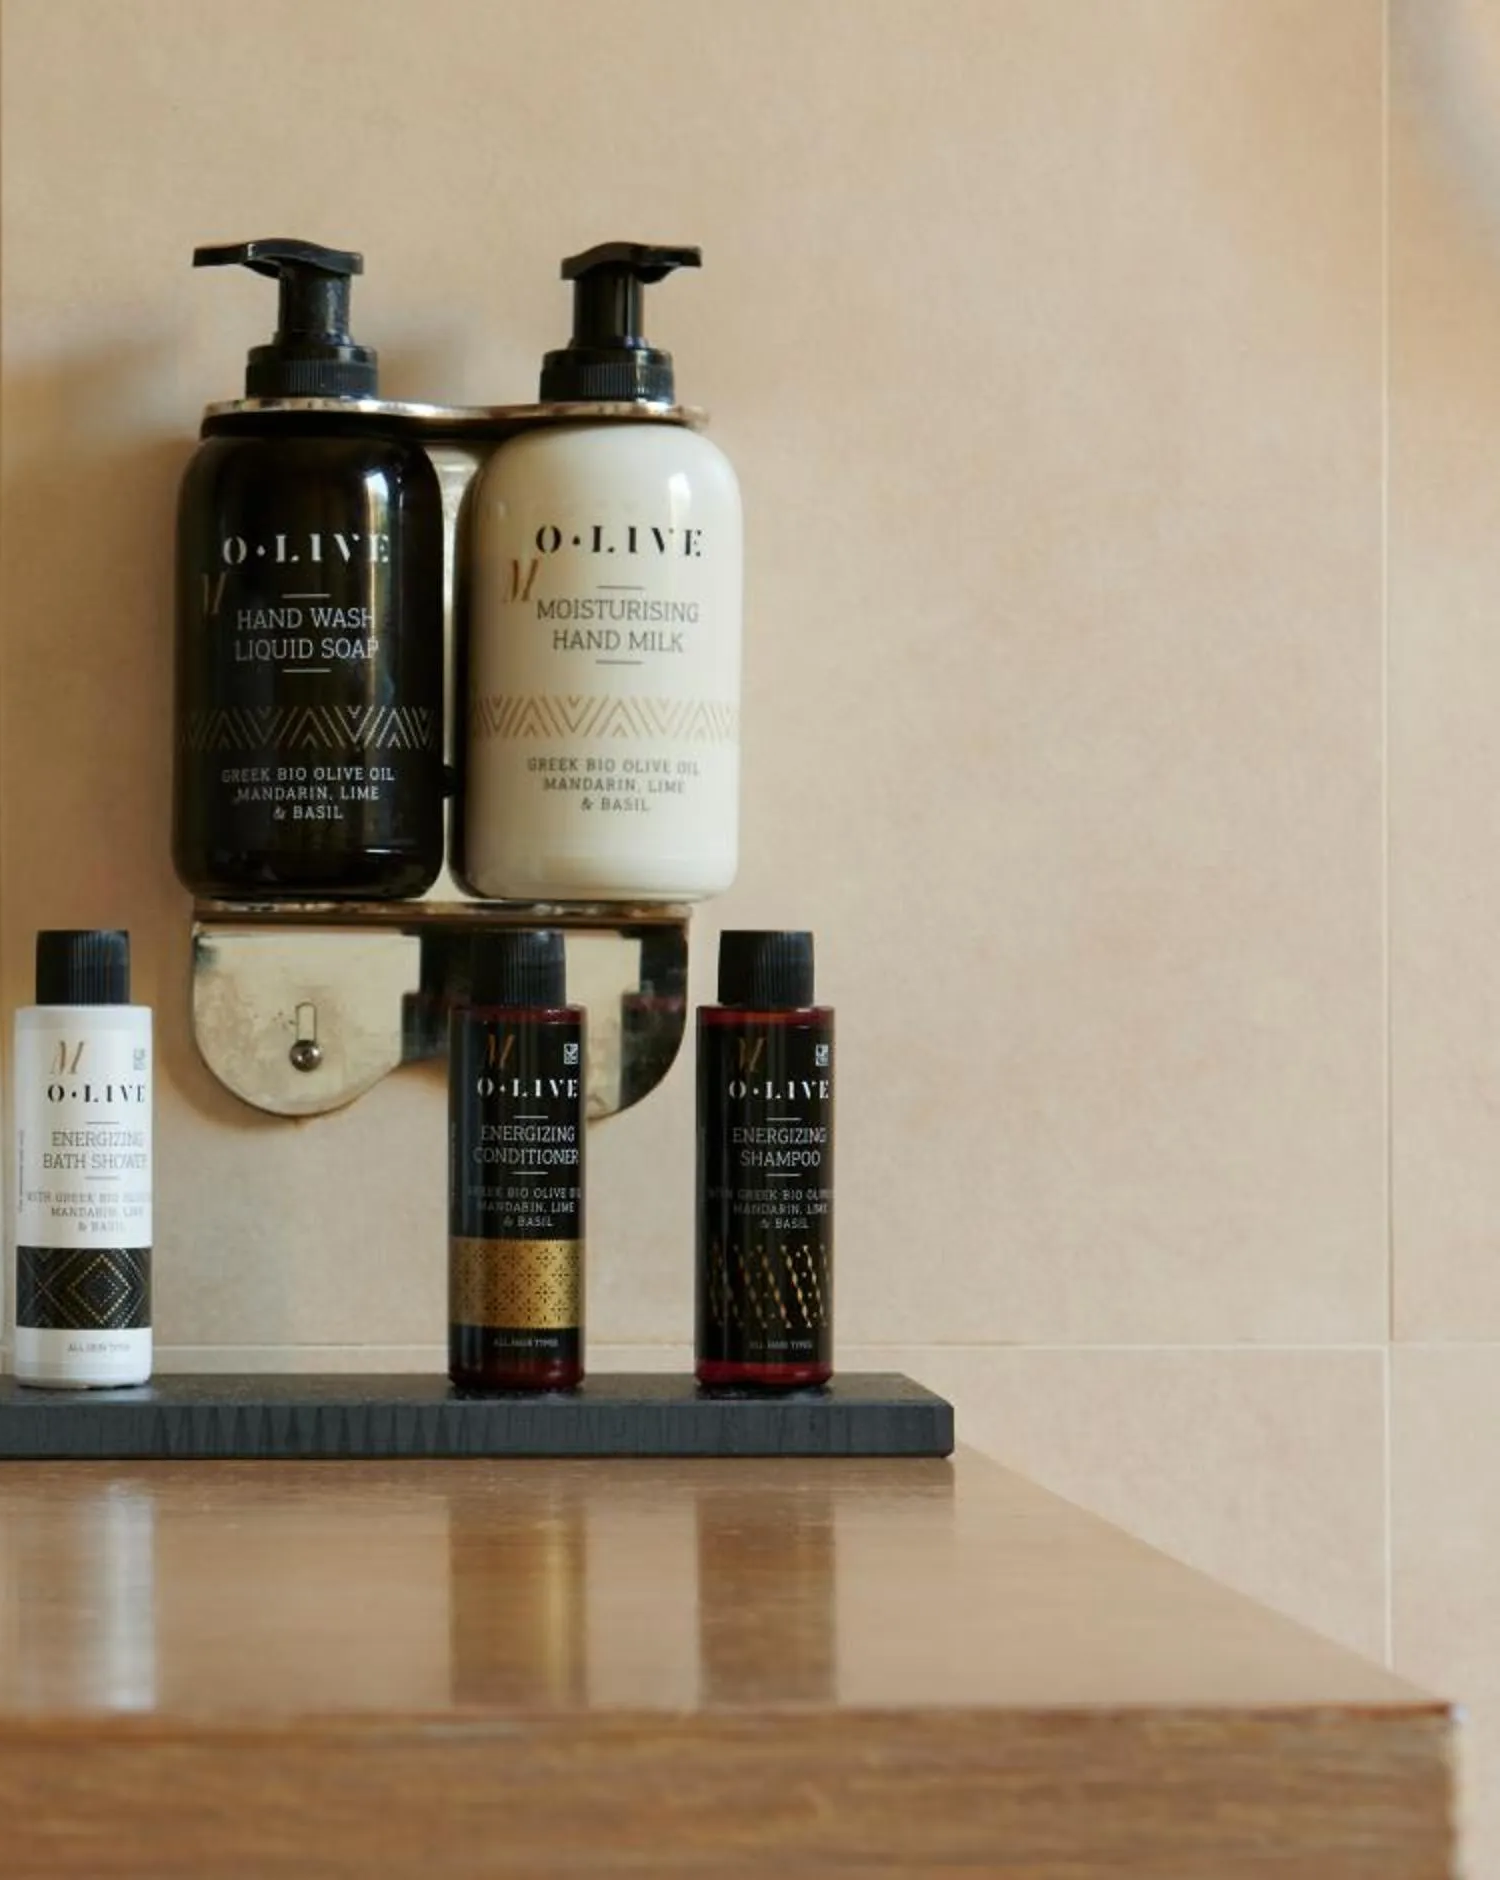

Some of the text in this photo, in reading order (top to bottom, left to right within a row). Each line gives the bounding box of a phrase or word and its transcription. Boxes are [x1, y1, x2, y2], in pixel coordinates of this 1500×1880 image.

[237, 606, 375, 631] HAND WASH
[536, 598, 700, 624] MOISTURISING
[235, 637, 380, 662] LIQUID SOAP
[553, 629, 685, 653] HAND MILK
[221, 767, 396, 784] GREEK BIO OLIVE OIL
[527, 757, 701, 777] GREEK BIO OLIVE OIL
[235, 785, 380, 803] MANDARIN, LIME
[543, 776, 686, 795] MANDARIN, LIME
[273, 804, 344, 821] & BASIL
[580, 796, 650, 812] & BASIL
[481, 1125, 576, 1141] ENERGIZING
[733, 1127, 828, 1145] ENERGIZING
[43, 1153, 86, 1169] BATH
[473, 1147, 580, 1165] CONDITIONER
[739, 1151, 821, 1168] SHAMPOO
